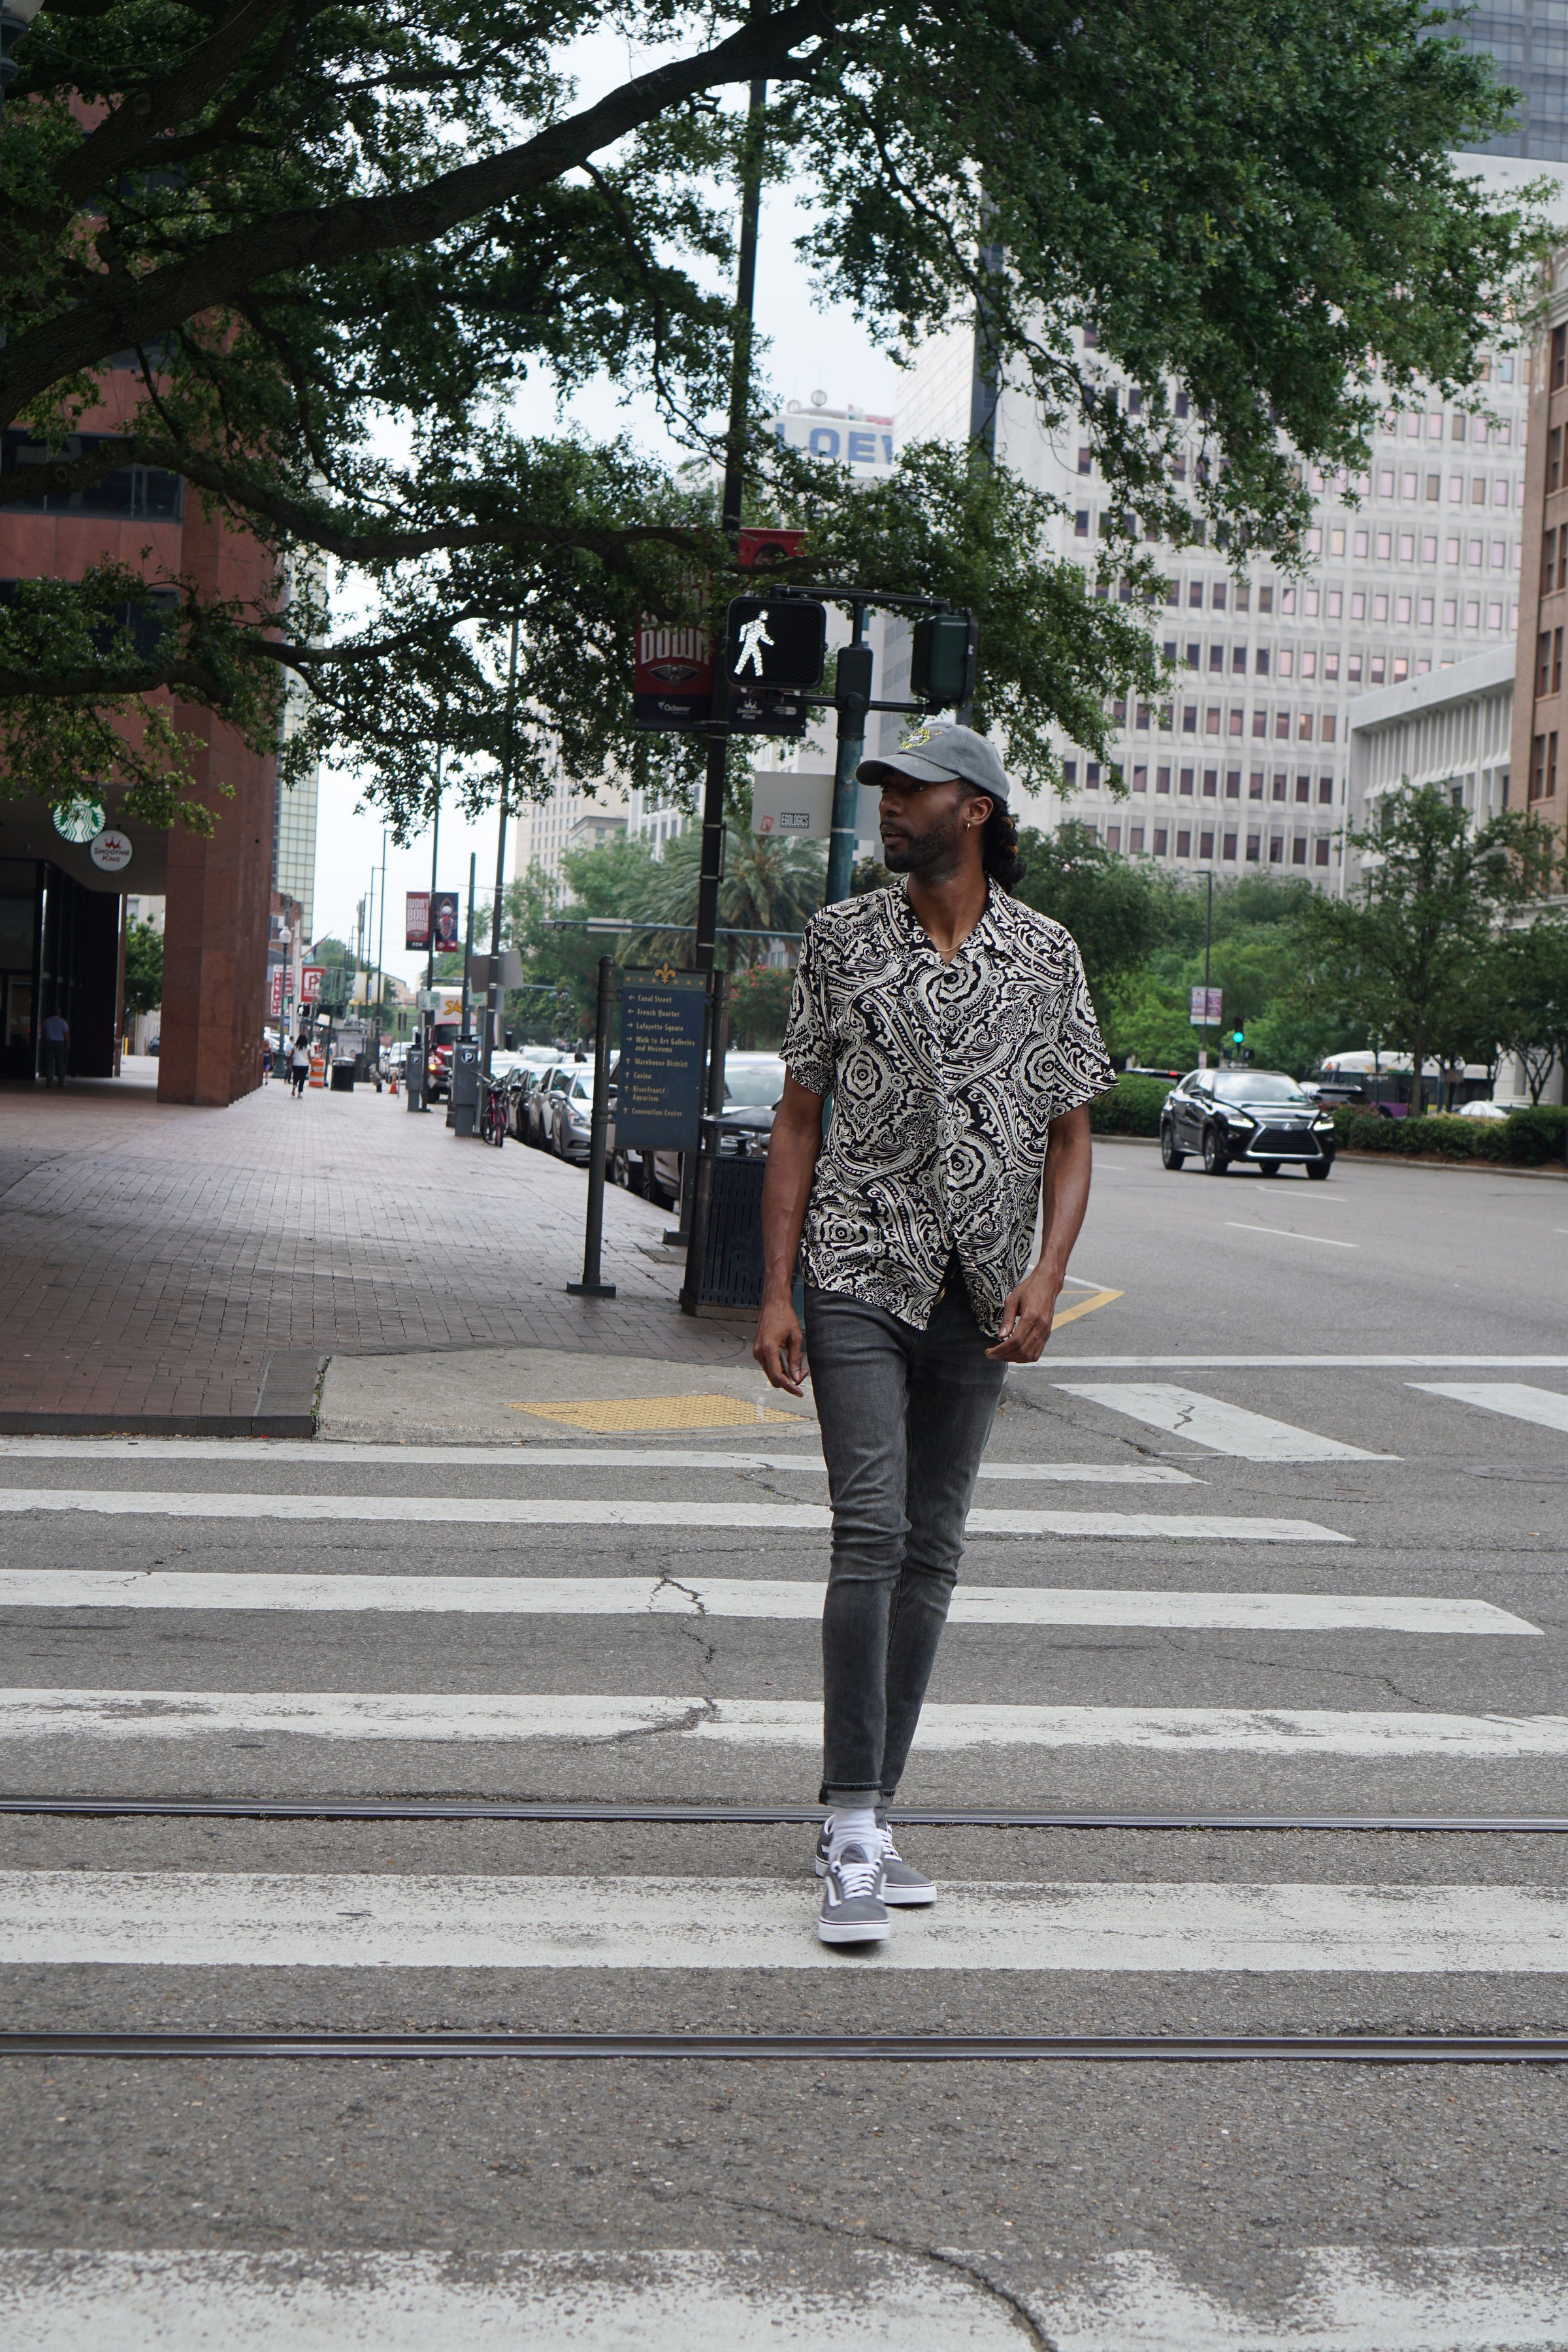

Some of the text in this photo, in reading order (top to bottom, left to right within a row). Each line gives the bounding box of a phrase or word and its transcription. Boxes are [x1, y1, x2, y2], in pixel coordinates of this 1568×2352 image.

[641, 627, 710, 666] DOWN
[638, 994, 653, 1002] Canal
[636, 1022, 662, 1031] Lafayette
[671, 1037, 695, 1046] Galleries
[634, 1058, 665, 1066] Warehouse
[633, 1085, 665, 1094] Riverfront/
[632, 1107, 662, 1116] Convention
